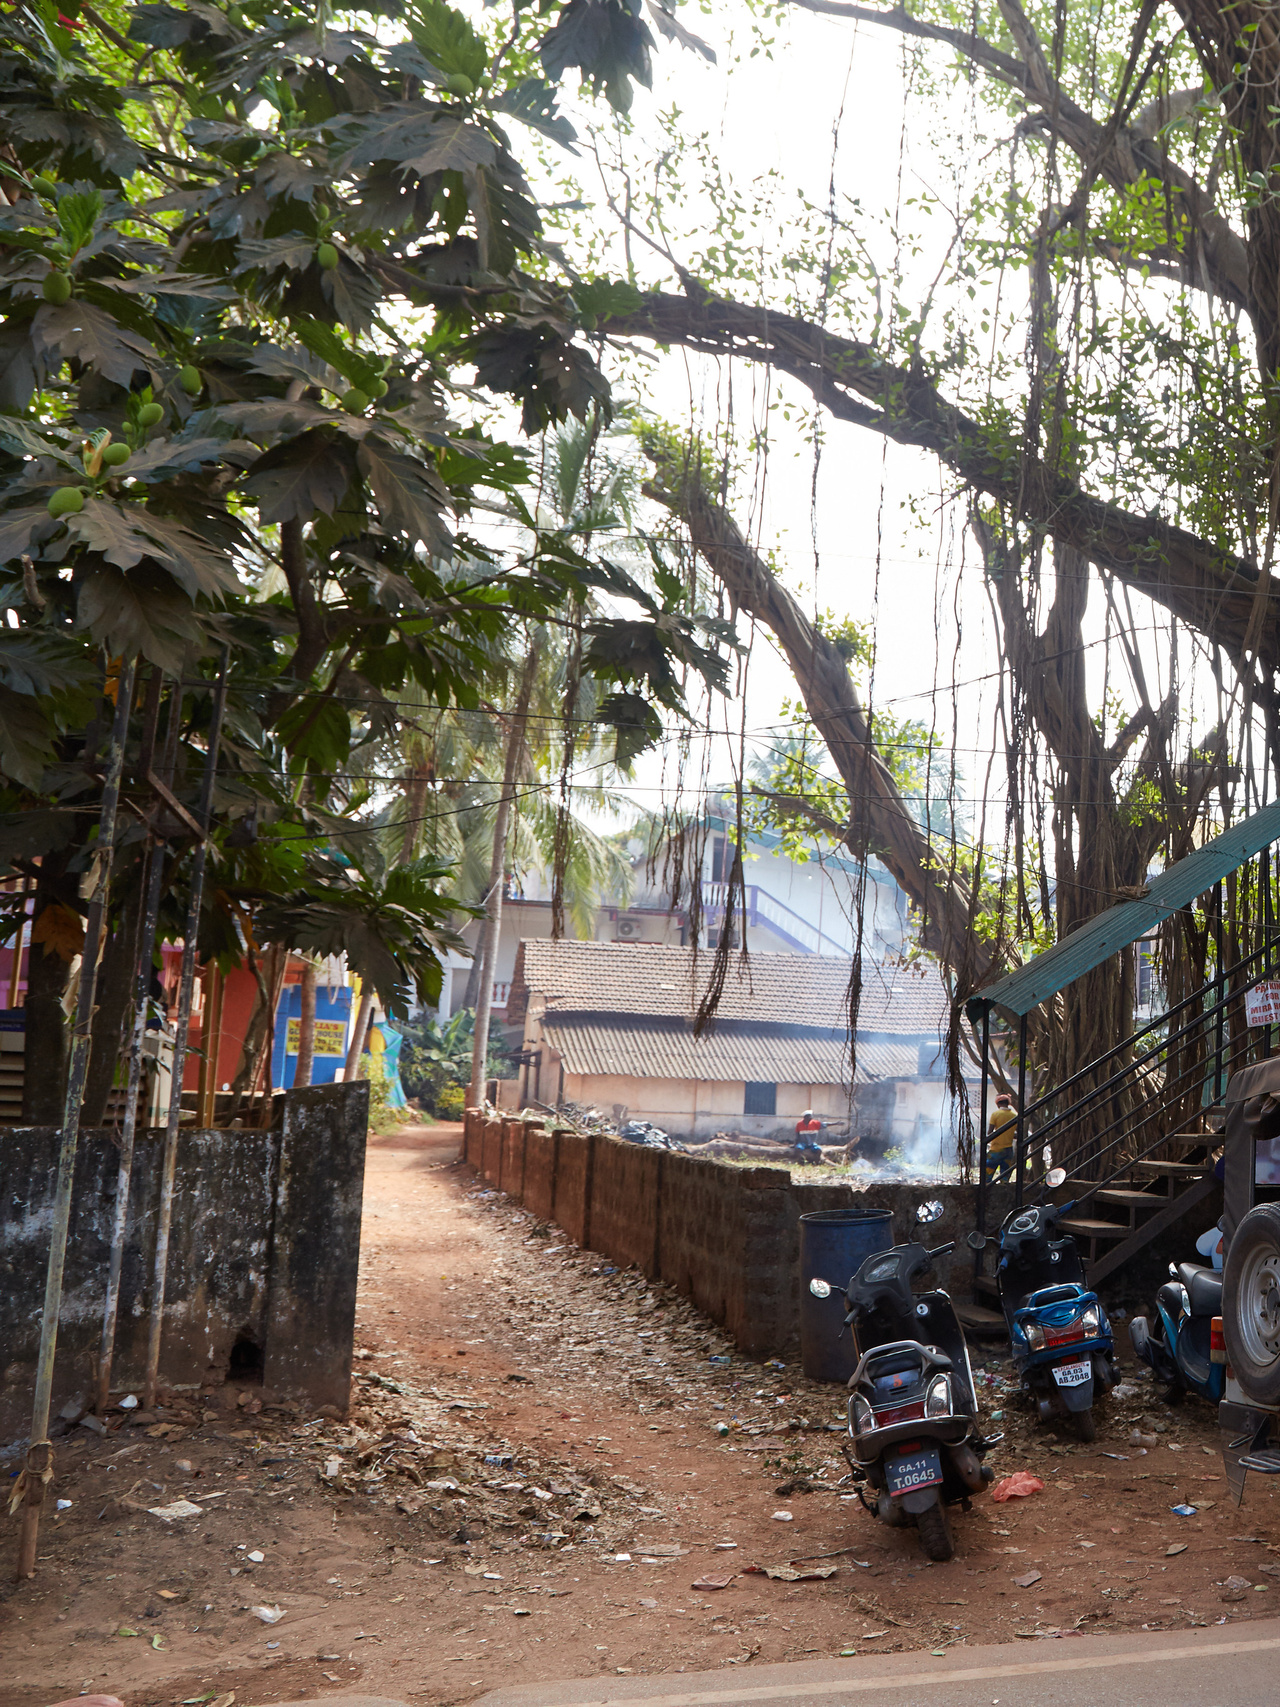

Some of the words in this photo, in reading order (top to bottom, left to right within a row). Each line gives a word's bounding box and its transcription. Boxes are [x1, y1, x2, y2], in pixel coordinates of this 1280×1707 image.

[1265, 993, 1279, 1001] FOR
[1250, 1003, 1272, 1014] MIRA
[1252, 1013, 1279, 1024] GUEST
[898, 1459, 927, 1473] GA.11
[893, 1468, 936, 1489] T.0645
